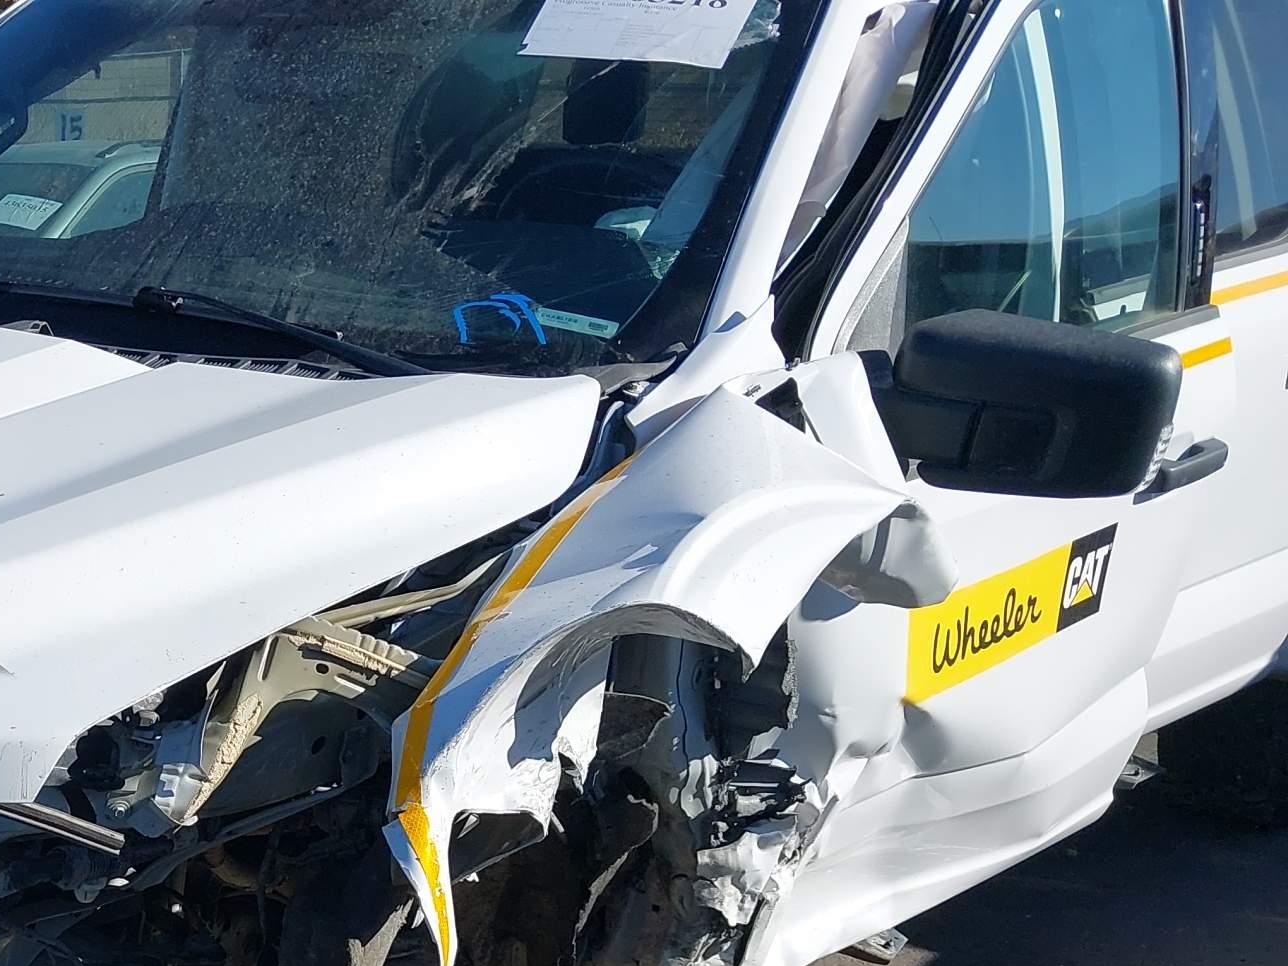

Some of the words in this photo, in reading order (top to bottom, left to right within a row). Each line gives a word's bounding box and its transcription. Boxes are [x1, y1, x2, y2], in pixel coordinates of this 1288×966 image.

[60, 113, 82, 141] 15
[1062, 543, 1113, 610] CAT
[932, 587, 1043, 674] Wheeler
